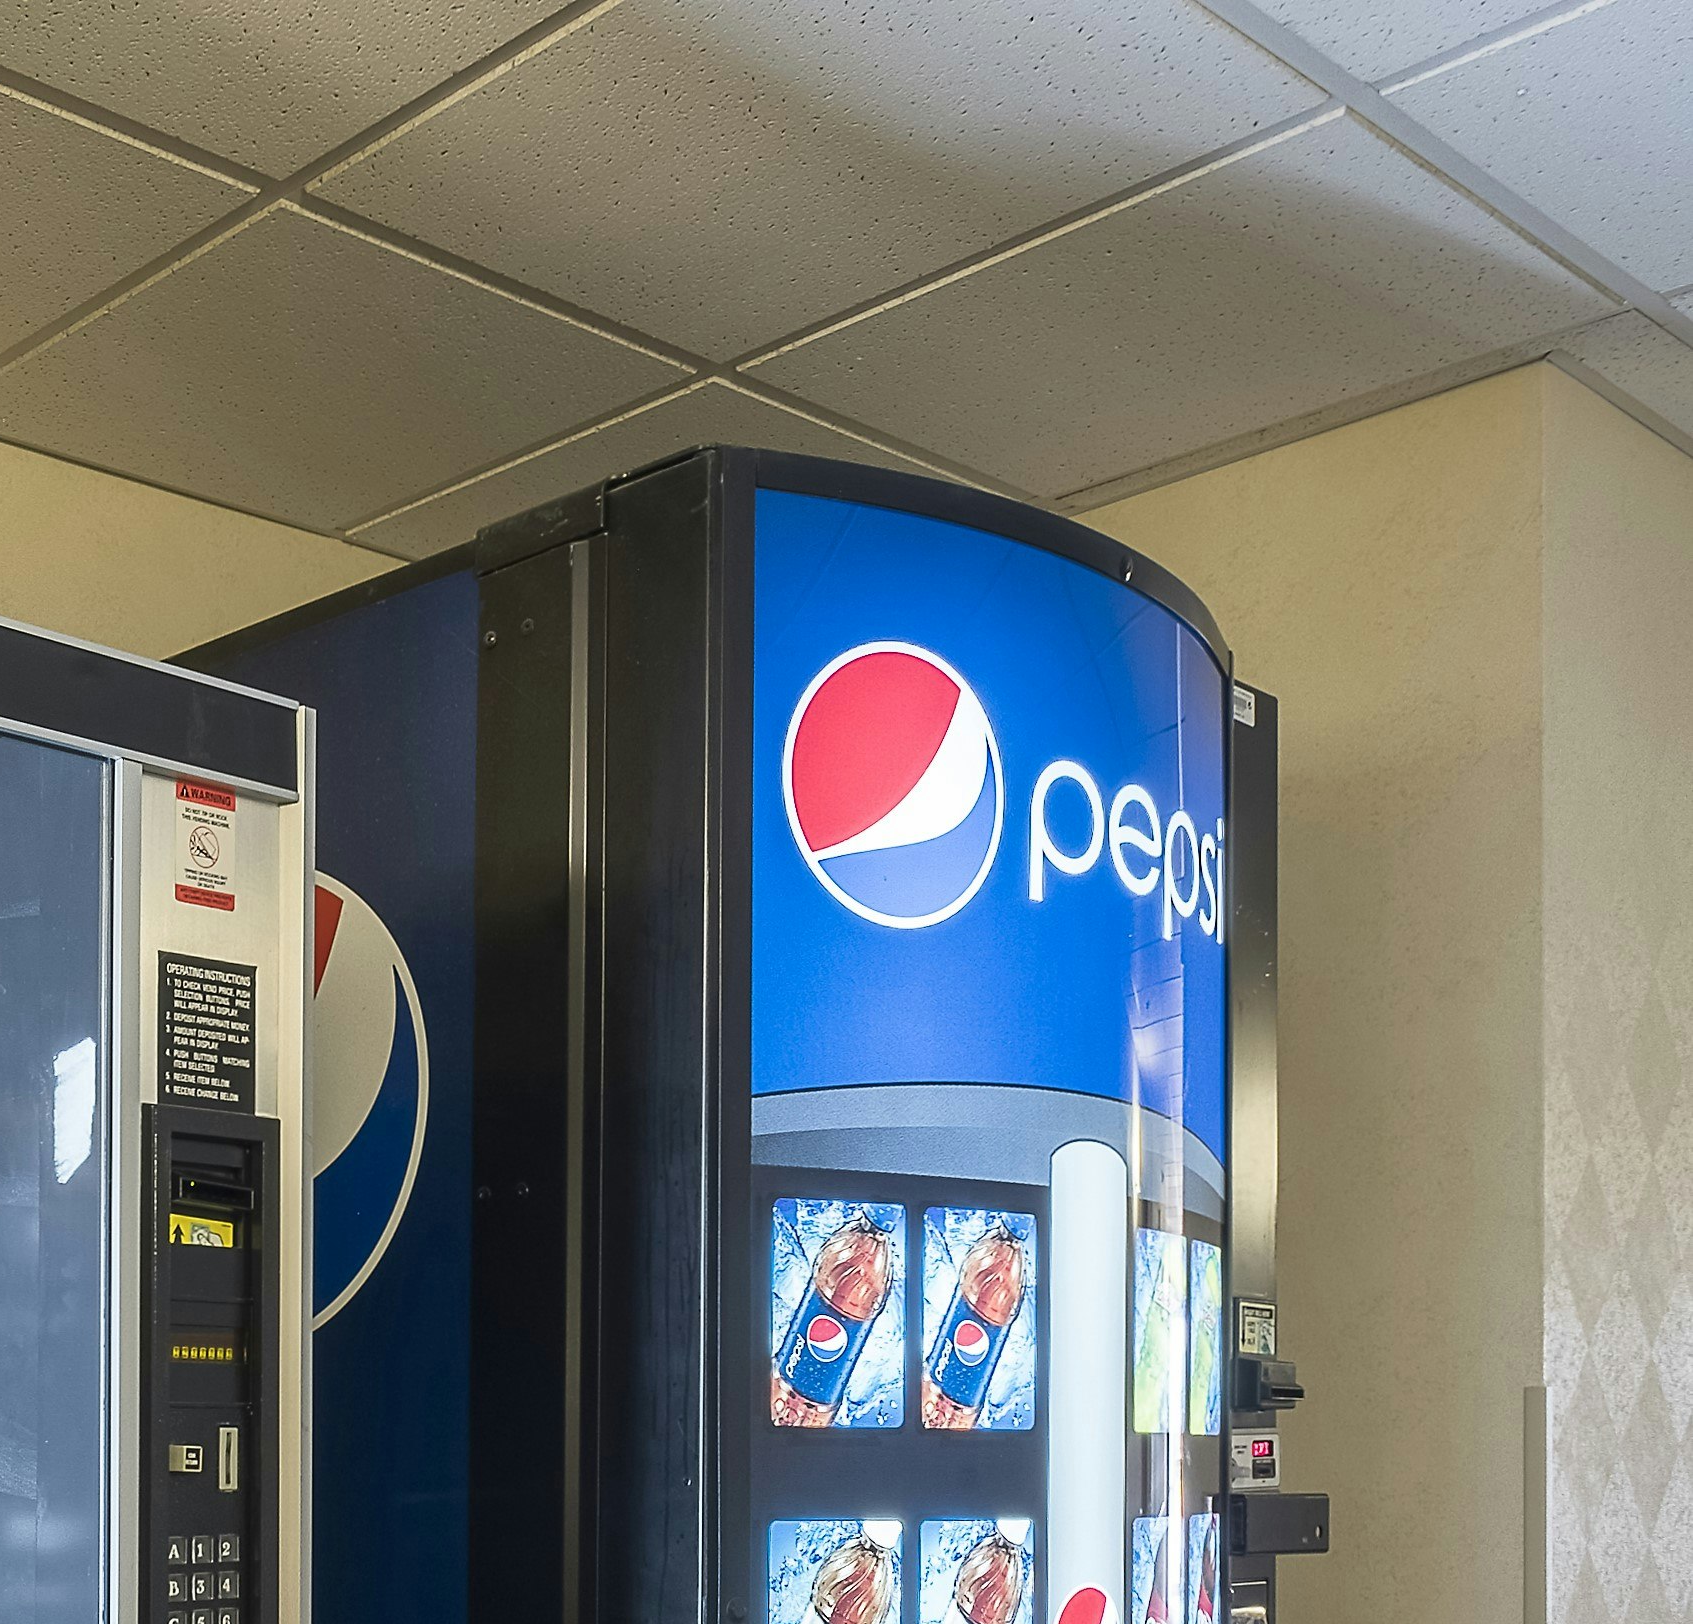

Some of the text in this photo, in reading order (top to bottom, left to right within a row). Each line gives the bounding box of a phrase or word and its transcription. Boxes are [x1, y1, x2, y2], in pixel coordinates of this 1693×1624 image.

[191, 788, 231, 807] WARNING
[1028, 759, 1224, 944] pepsi
[166, 962, 204, 979] OPERATING
[786, 1334, 806, 1378] pepsi
[935, 1337, 954, 1382] pepsi
[168, 1542, 231, 1559] A 1 2
[168, 1578, 230, 1596] B 3 4
